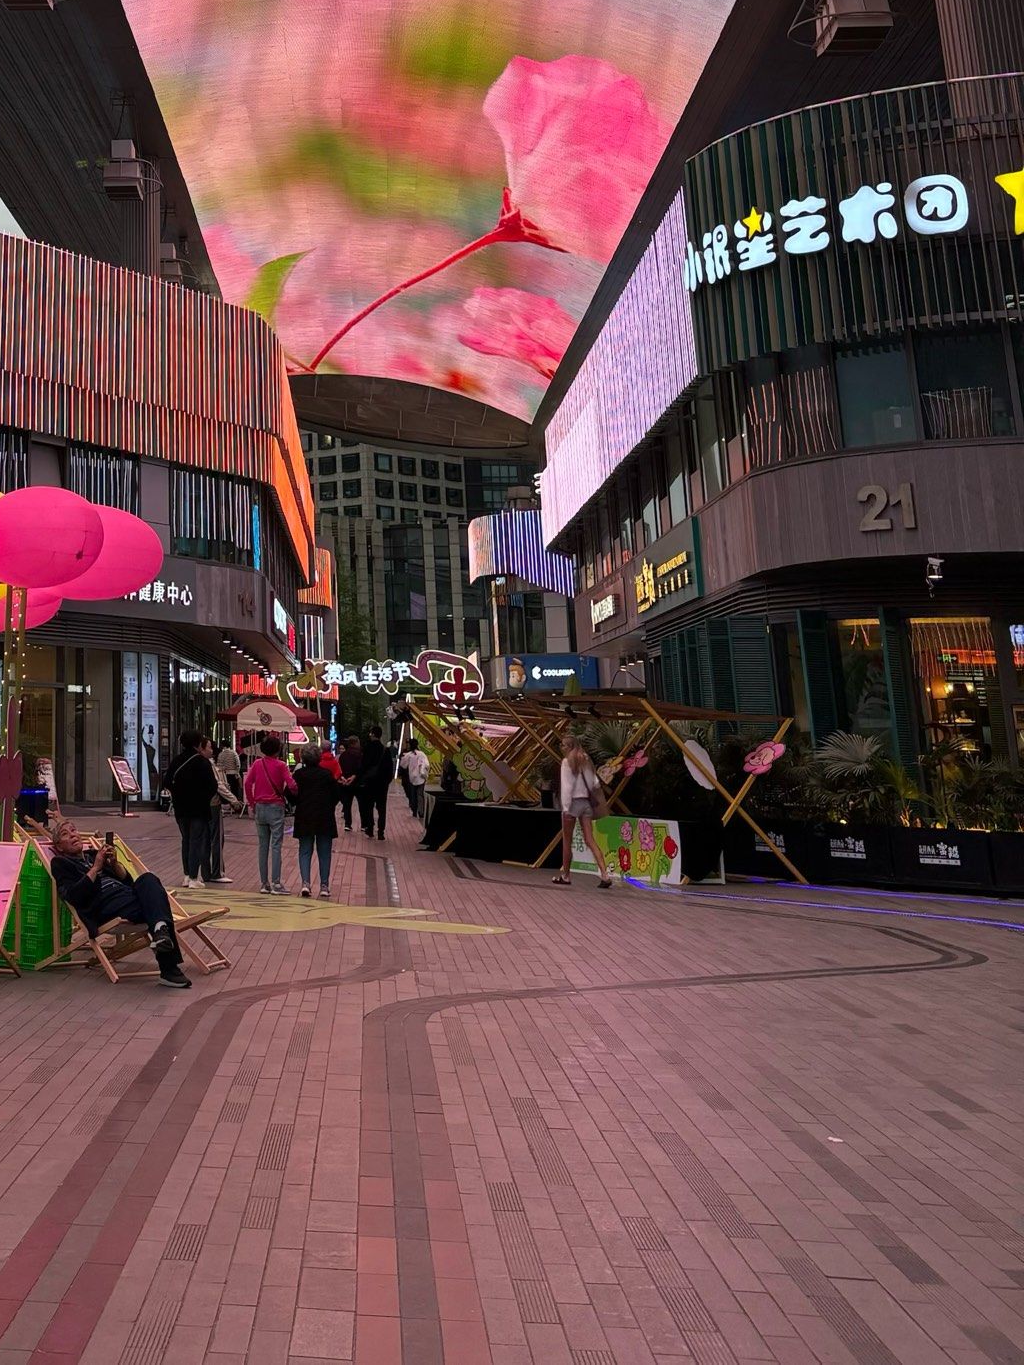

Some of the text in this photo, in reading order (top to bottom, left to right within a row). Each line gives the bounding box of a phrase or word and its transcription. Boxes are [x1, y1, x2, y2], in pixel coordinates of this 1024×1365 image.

[857, 482, 916, 532] 21
[124, 580, 193, 606] 健康中心
